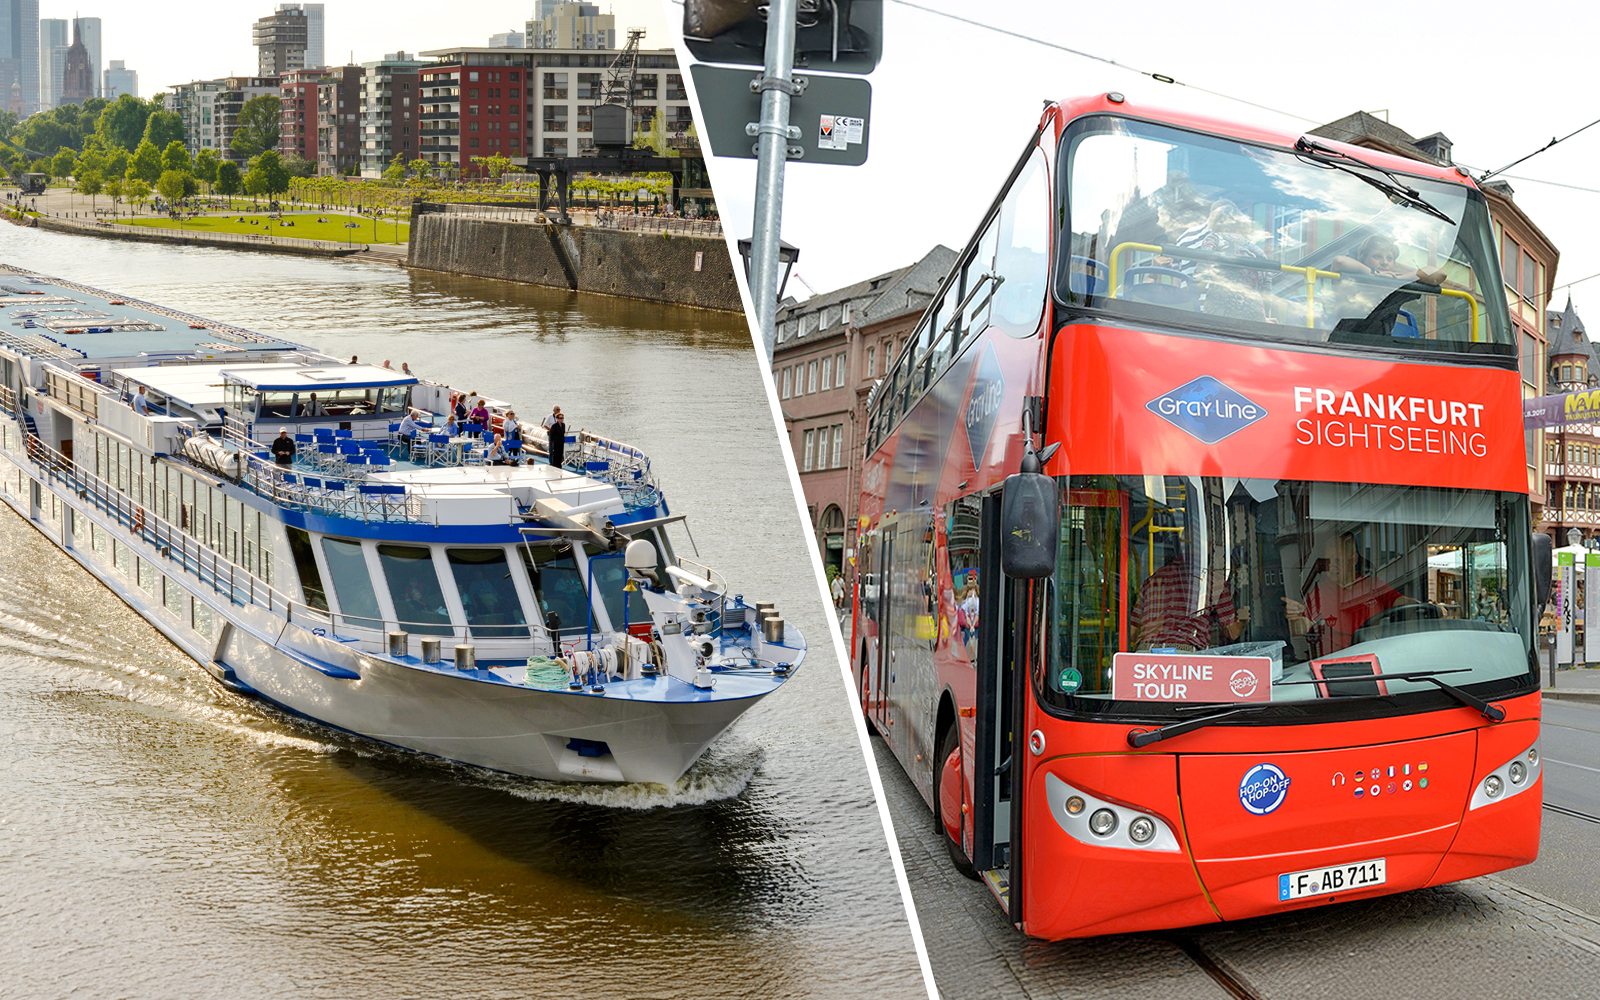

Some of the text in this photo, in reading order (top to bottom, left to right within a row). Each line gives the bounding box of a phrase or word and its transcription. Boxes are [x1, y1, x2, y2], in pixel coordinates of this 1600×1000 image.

[1294, 386, 1484, 428] FRANKFURT
[1296, 418, 1487, 457] SIGHTSEEING
[1133, 663, 1213, 681] SKYLINE
[1133, 682, 1187, 699] TOUR
[1240, 774, 1277, 798] HOP-ON
[1249, 778, 1290, 803] HOP-OFF
[1297, 863, 1379, 895] F AB 711
